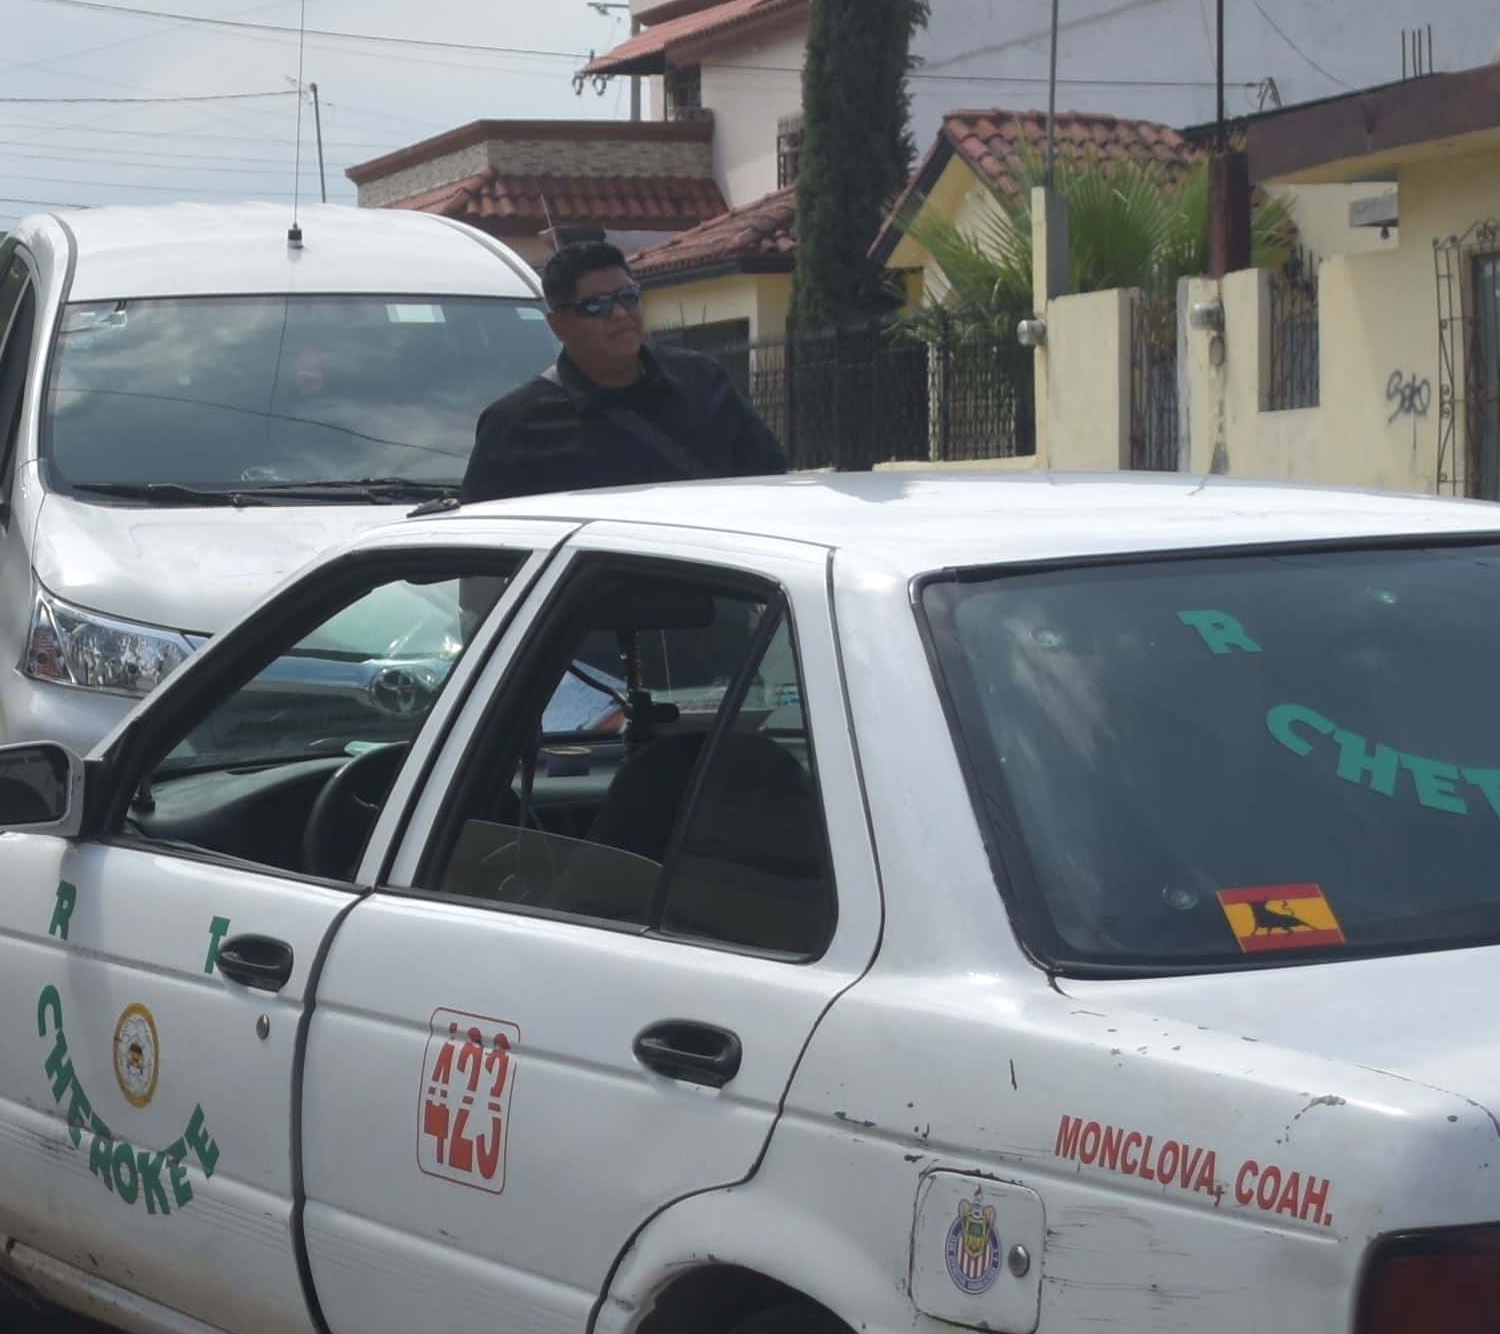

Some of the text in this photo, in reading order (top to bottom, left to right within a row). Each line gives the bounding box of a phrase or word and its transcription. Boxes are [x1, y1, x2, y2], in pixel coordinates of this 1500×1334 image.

[1177, 608, 1263, 655] R
[49, 880, 231, 974] R T
[37, 984, 220, 1215] CHEROKEE
[424, 1021, 511, 1180] 423
[1055, 1114, 1334, 1227] MONCLOVA, COAH.
